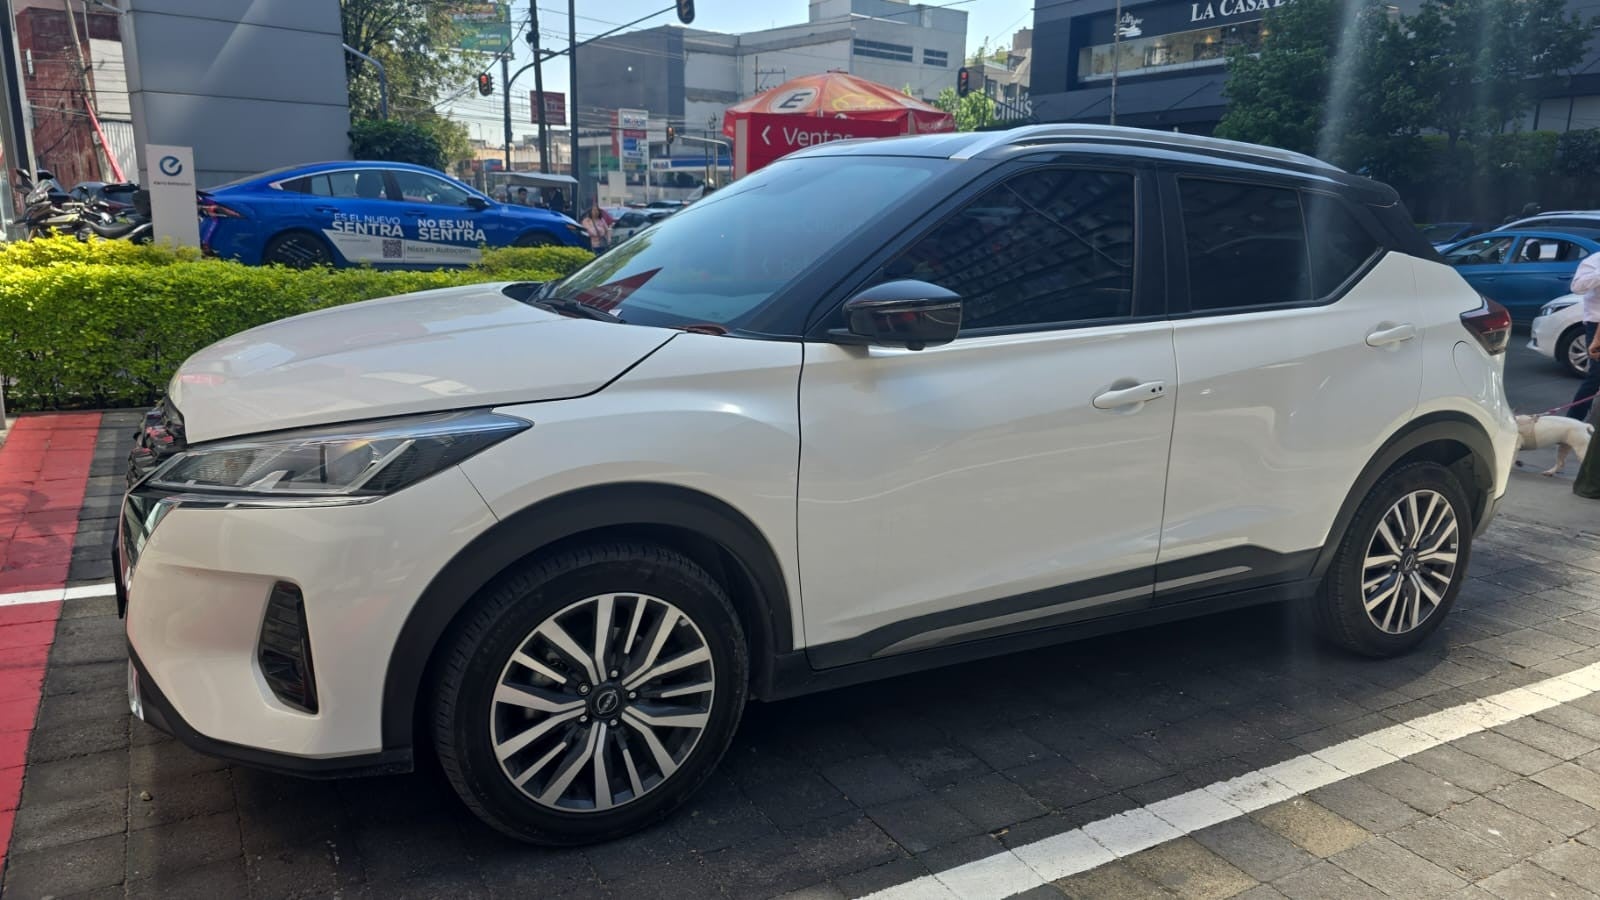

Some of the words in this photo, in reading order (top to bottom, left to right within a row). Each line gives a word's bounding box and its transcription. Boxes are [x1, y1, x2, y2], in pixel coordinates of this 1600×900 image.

[1190, 2, 1215, 22] LA
[1219, 0, 1270, 16] CASA
[778, 92, 812, 109] E
[333, 213, 348, 222] ES
[350, 214, 361, 223] EL
[364, 215, 401, 225] NUEVO
[417, 219, 436, 229] NO
[439, 219, 454, 229] ES
[457, 220, 474, 230] UN
[331, 221, 404, 238] SENTRA
[418, 228, 487, 242] SENTRA
[407, 245, 434, 254] Nissan
